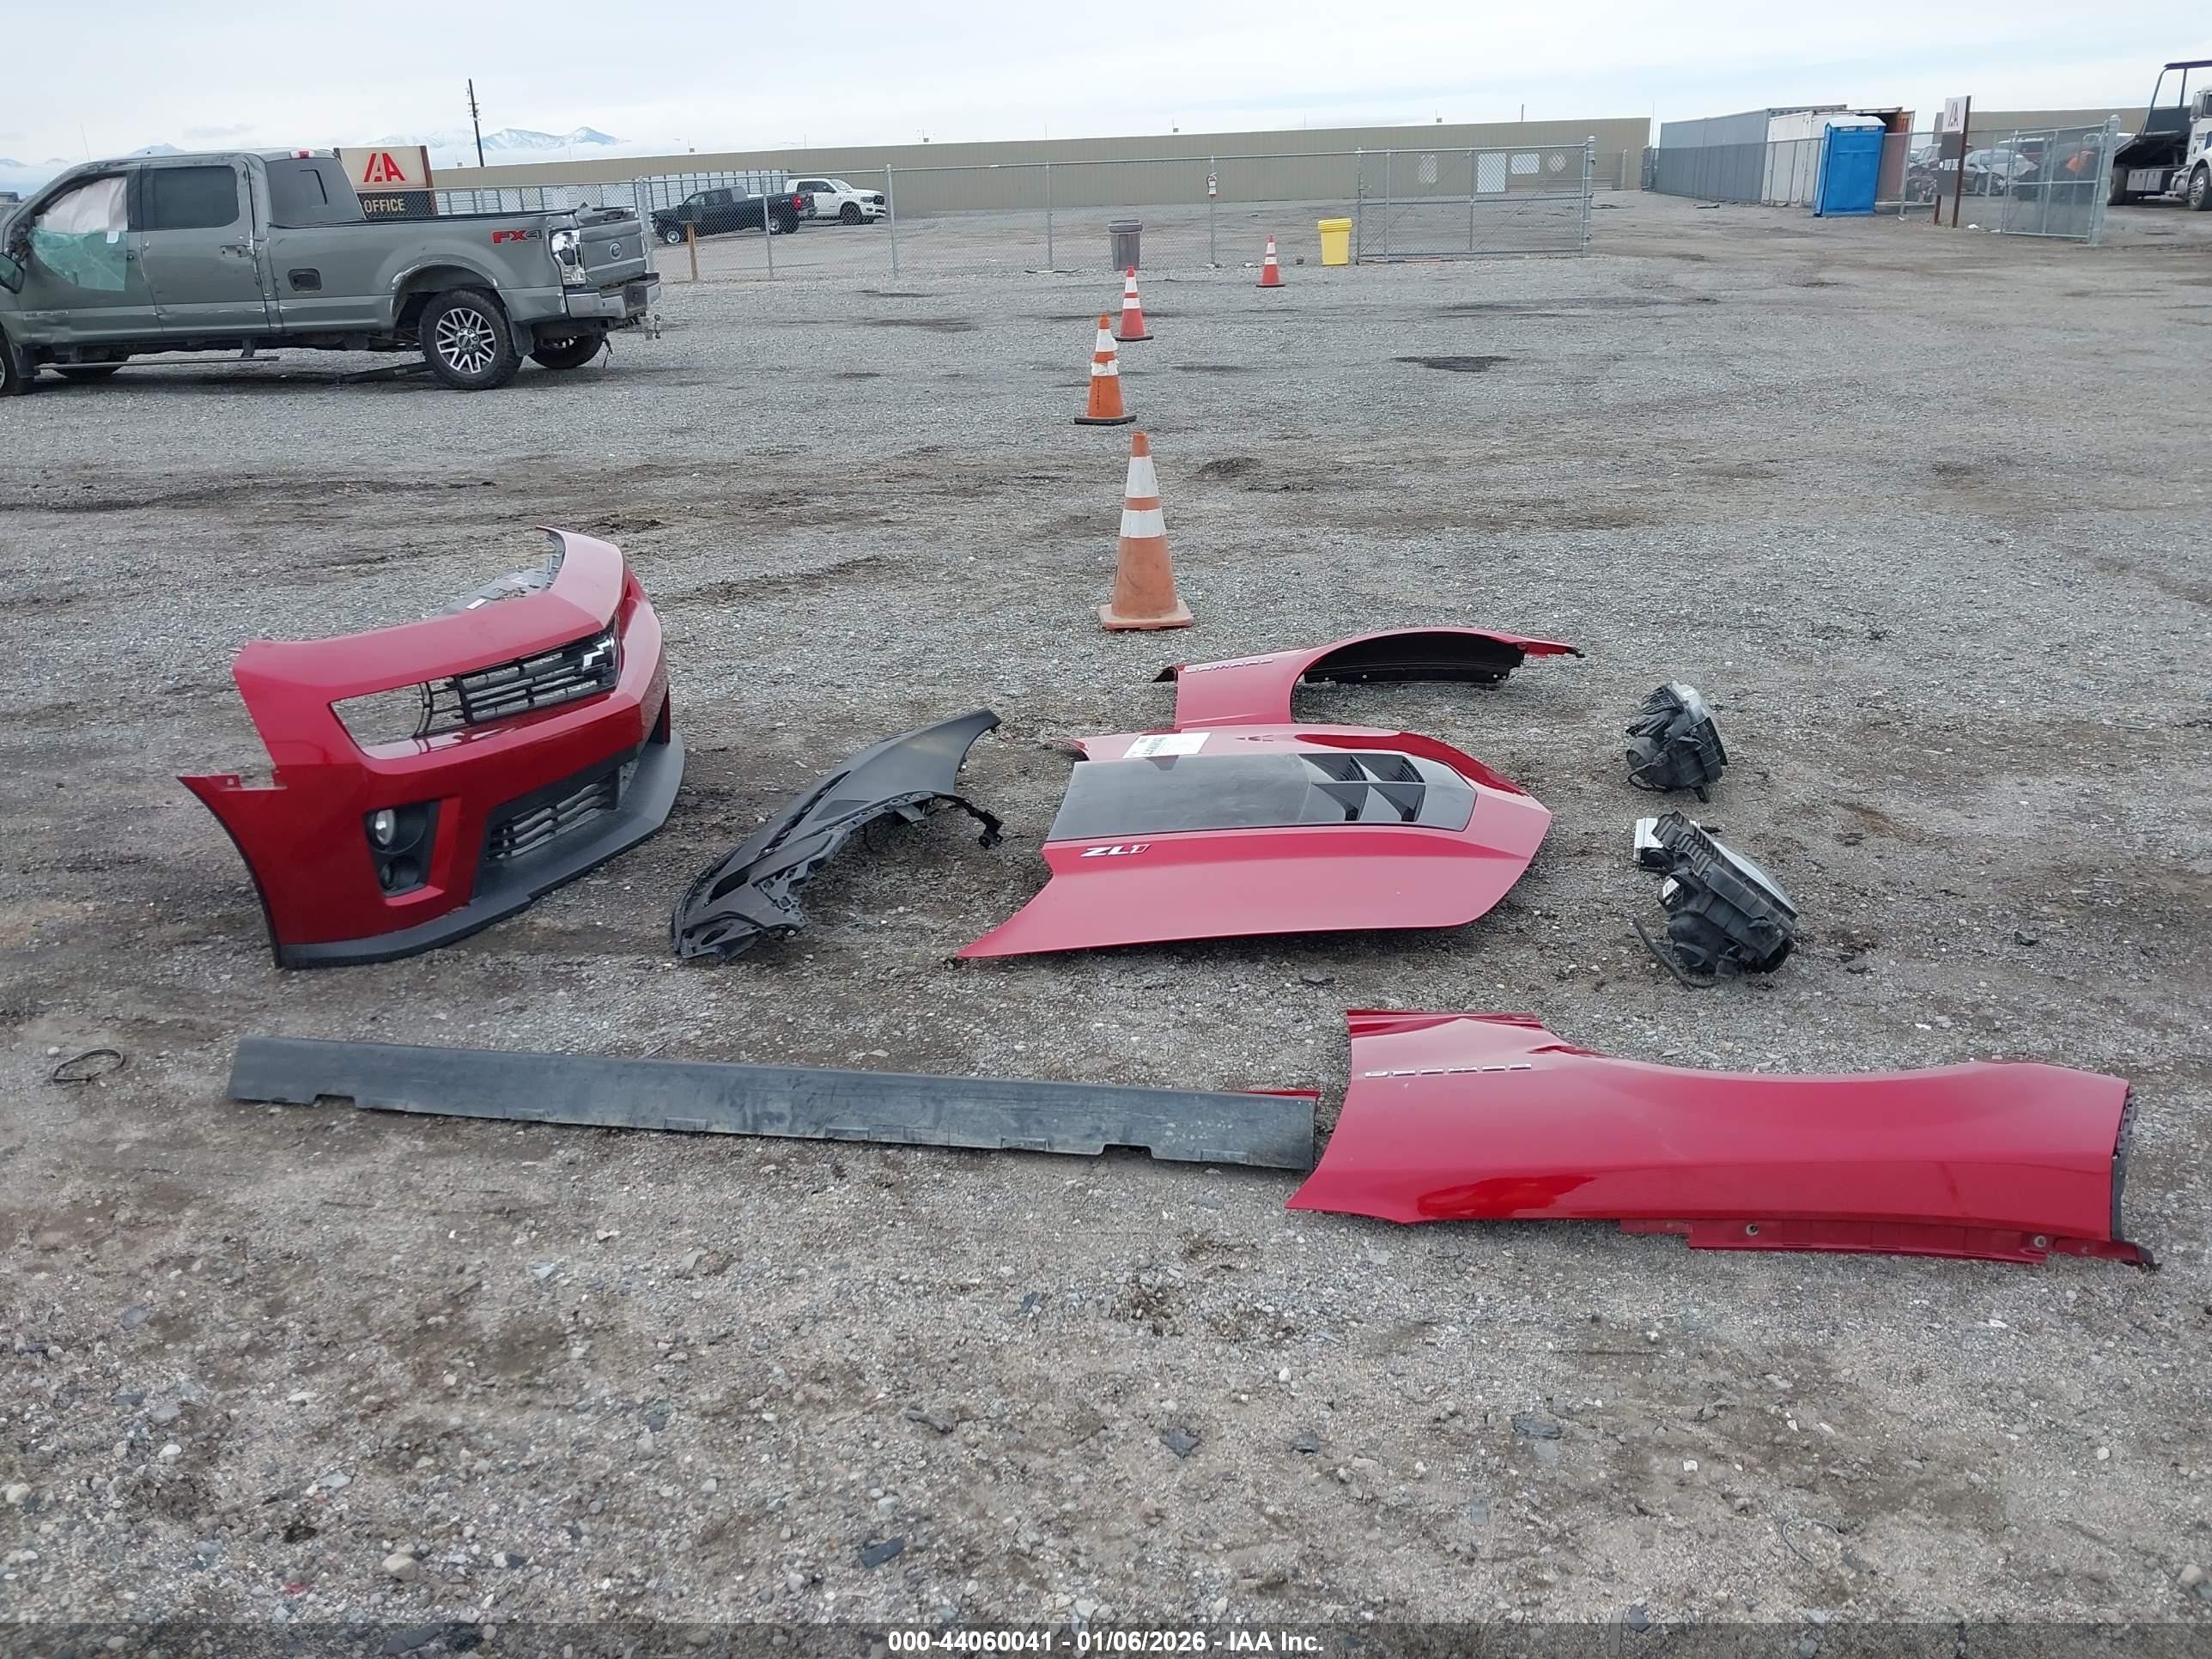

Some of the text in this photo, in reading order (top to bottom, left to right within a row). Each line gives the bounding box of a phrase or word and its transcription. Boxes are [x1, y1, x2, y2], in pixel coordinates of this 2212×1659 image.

[363, 198, 405, 213] OFFICE
[492, 229, 543, 245] FX4
[1080, 843, 1152, 858] ZL1
